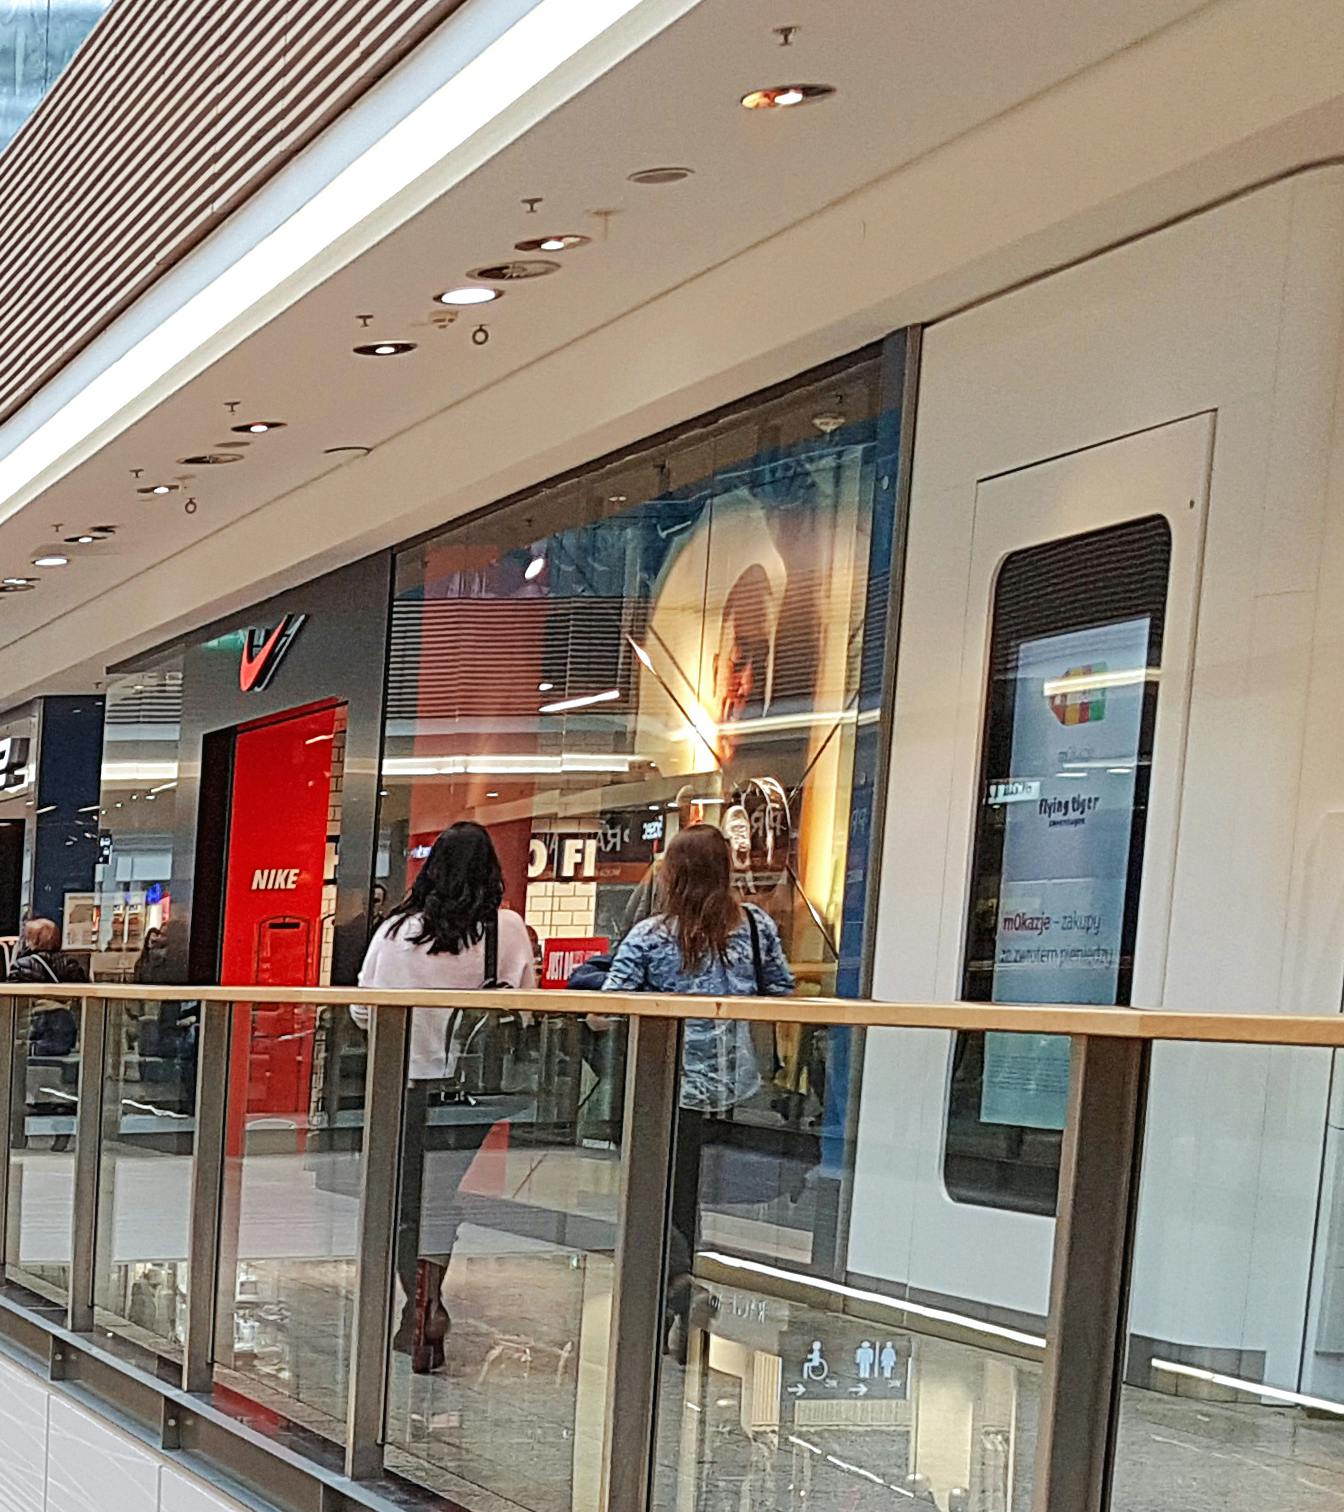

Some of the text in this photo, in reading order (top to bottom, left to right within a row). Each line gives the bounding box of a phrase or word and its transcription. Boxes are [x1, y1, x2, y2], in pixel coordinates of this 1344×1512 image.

[1038, 794, 1100, 818] flying tiger
[251, 868, 300, 890] NIKE
[1061, 911, 1102, 935] zakupy
